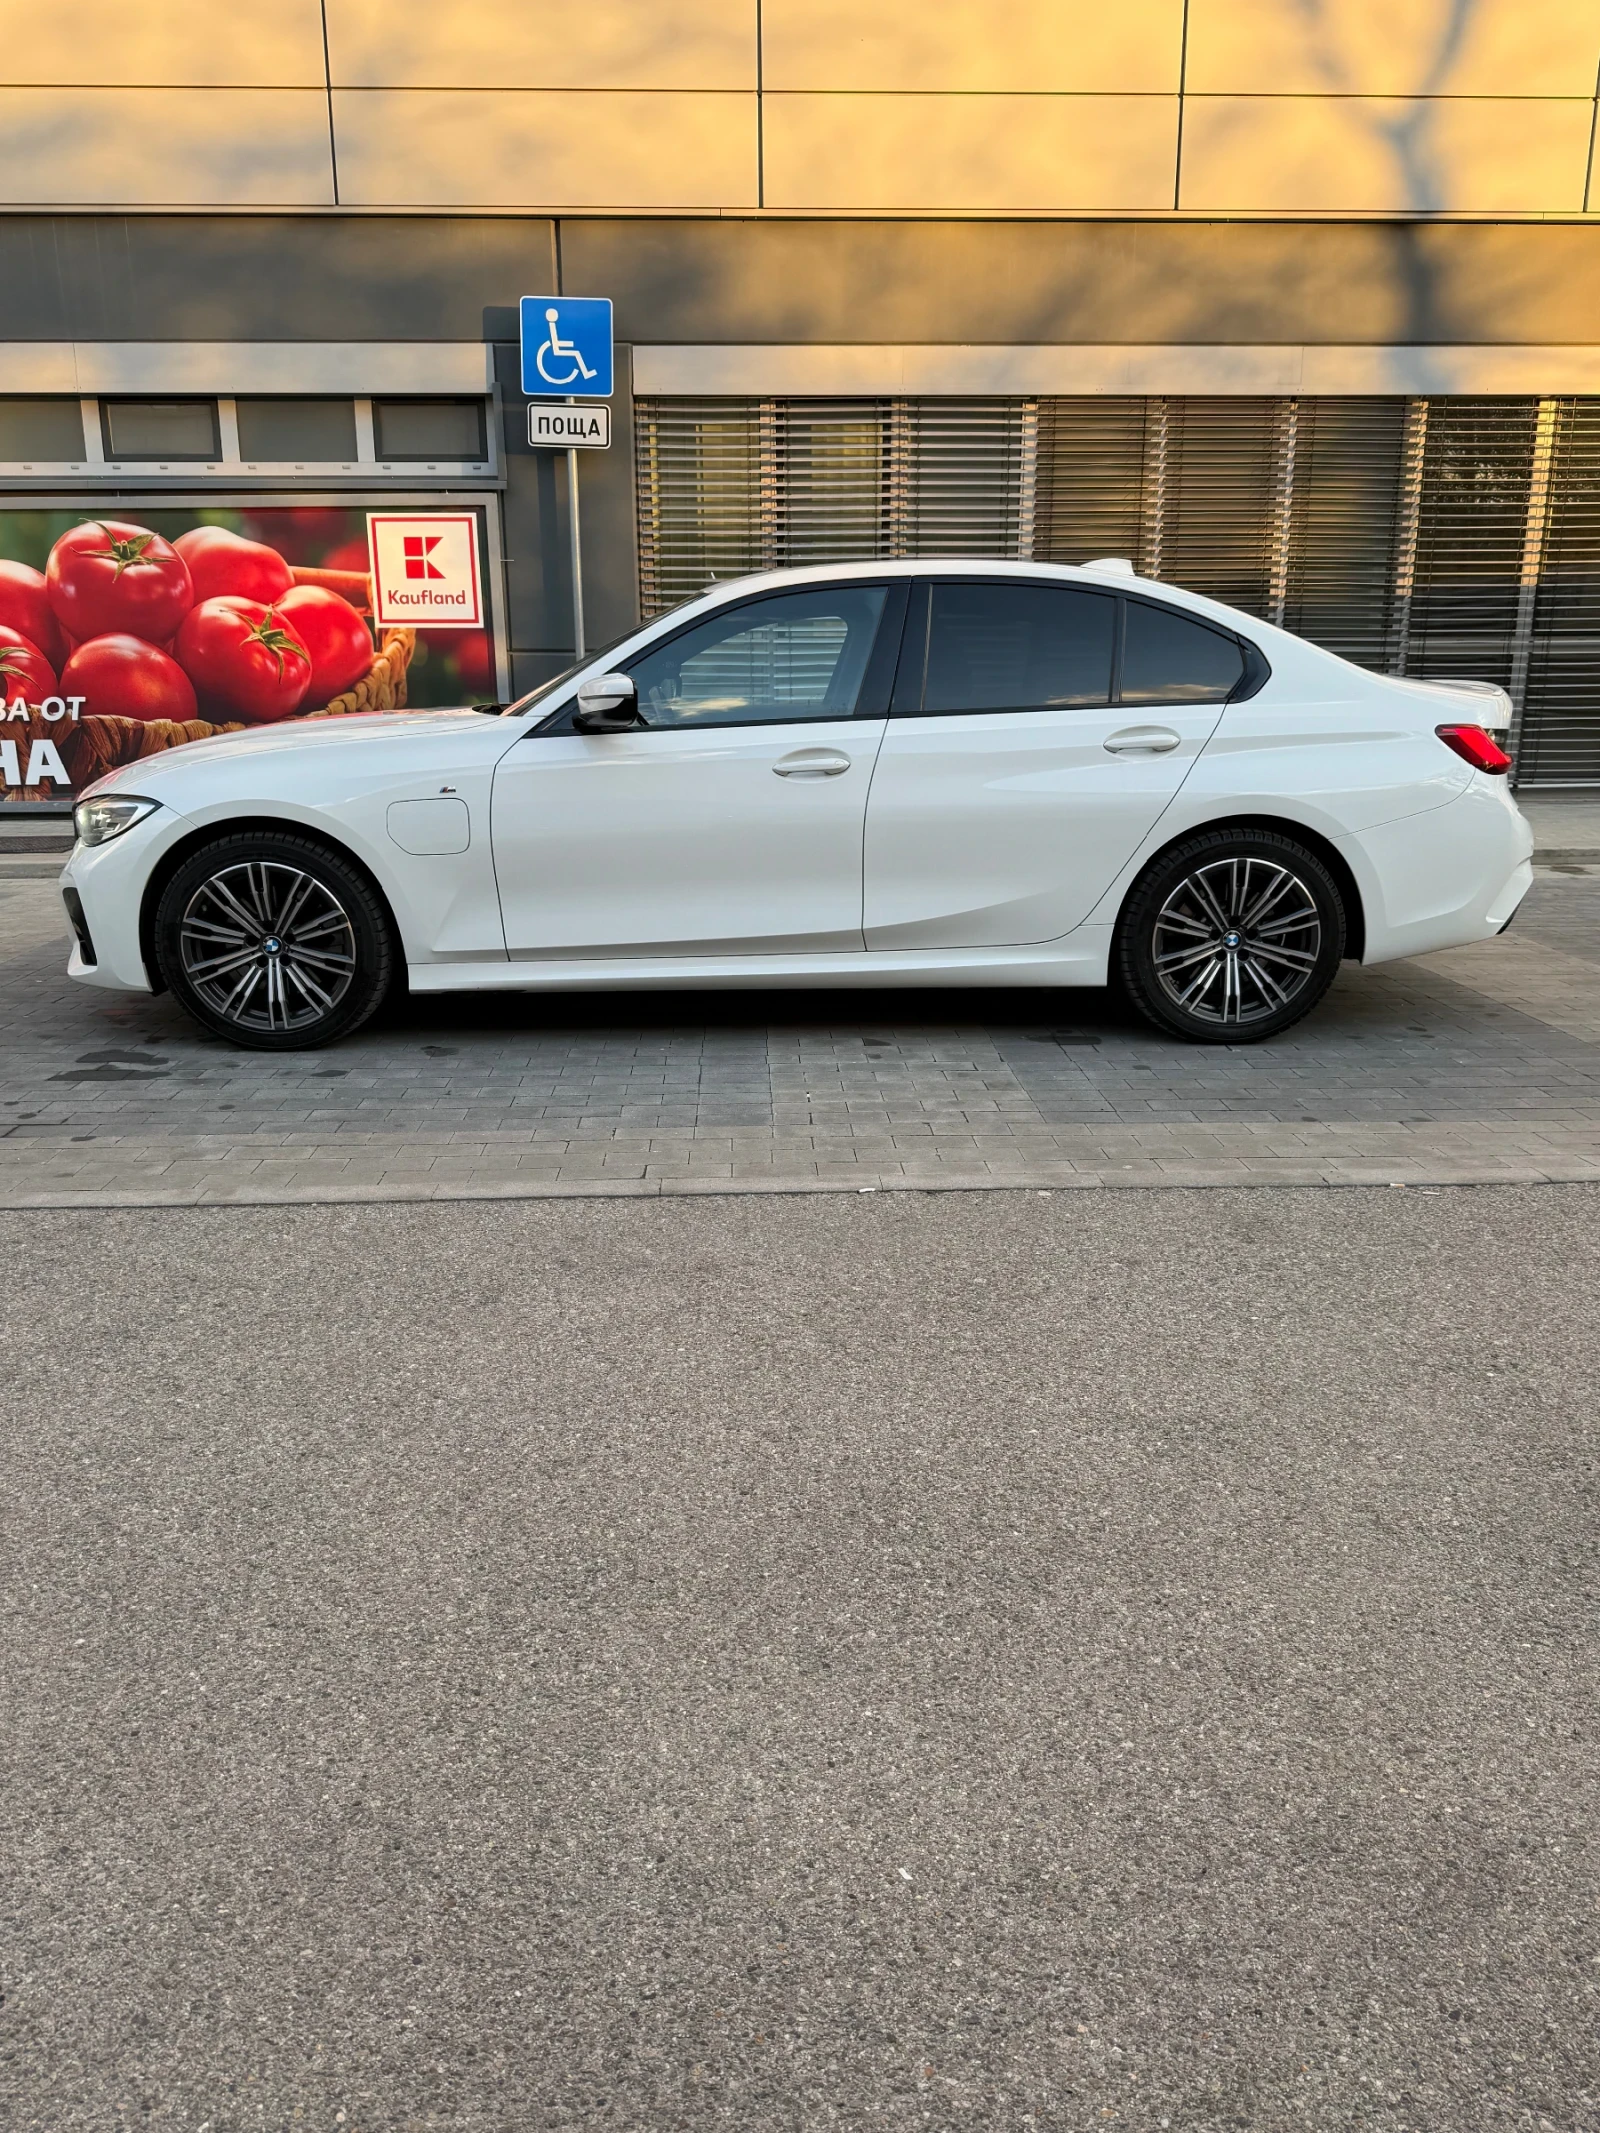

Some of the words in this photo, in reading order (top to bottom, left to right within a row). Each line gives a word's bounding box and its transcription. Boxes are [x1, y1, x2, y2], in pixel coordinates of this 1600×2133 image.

[538, 416, 600, 438] ПОЩА
[387, 589, 466, 605] Kaufland
[41, 696, 86, 721] ОТ
